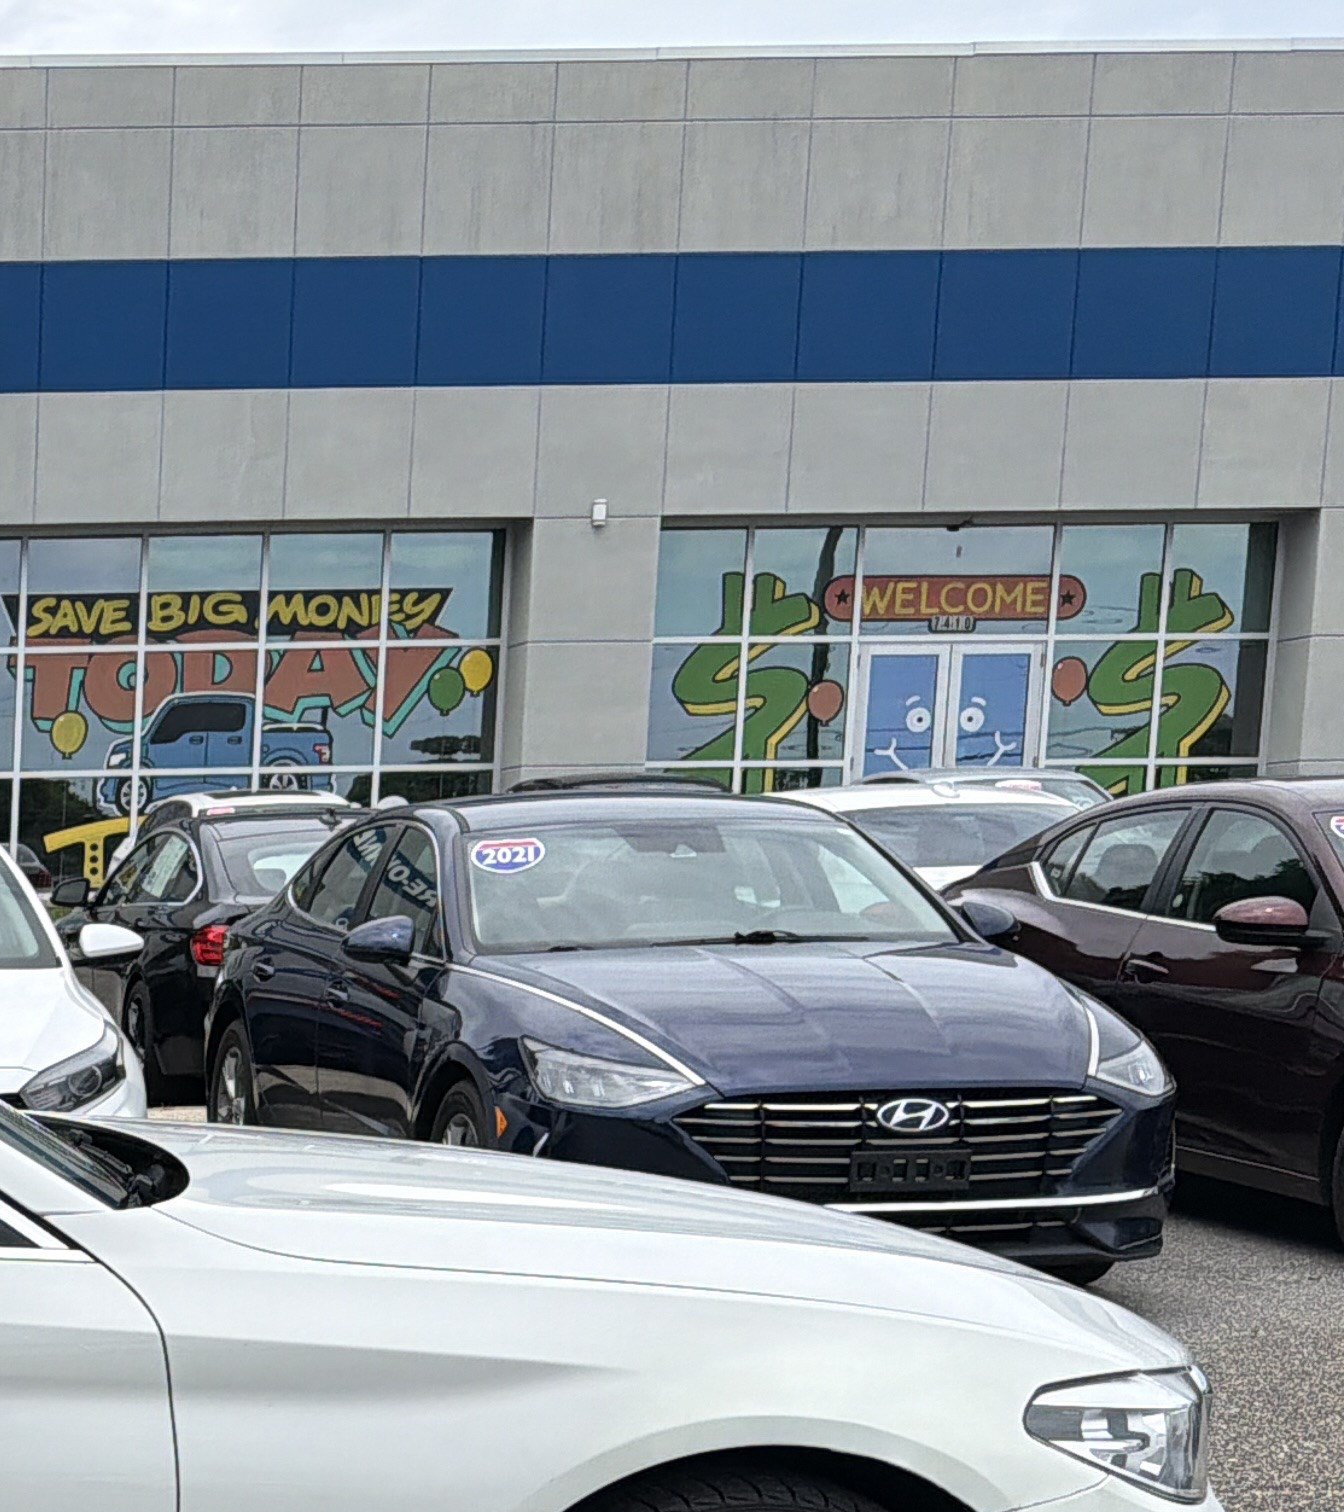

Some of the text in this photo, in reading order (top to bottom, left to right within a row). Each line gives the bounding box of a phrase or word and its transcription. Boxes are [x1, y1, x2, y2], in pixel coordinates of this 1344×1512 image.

[27, 592, 442, 637] SAVE BIG MONEY
[863, 581, 1049, 615] WELCOME
[934, 615, 972, 631] 7410
[8, 622, 461, 738] TODAY
[481, 846, 536, 866] 2021
